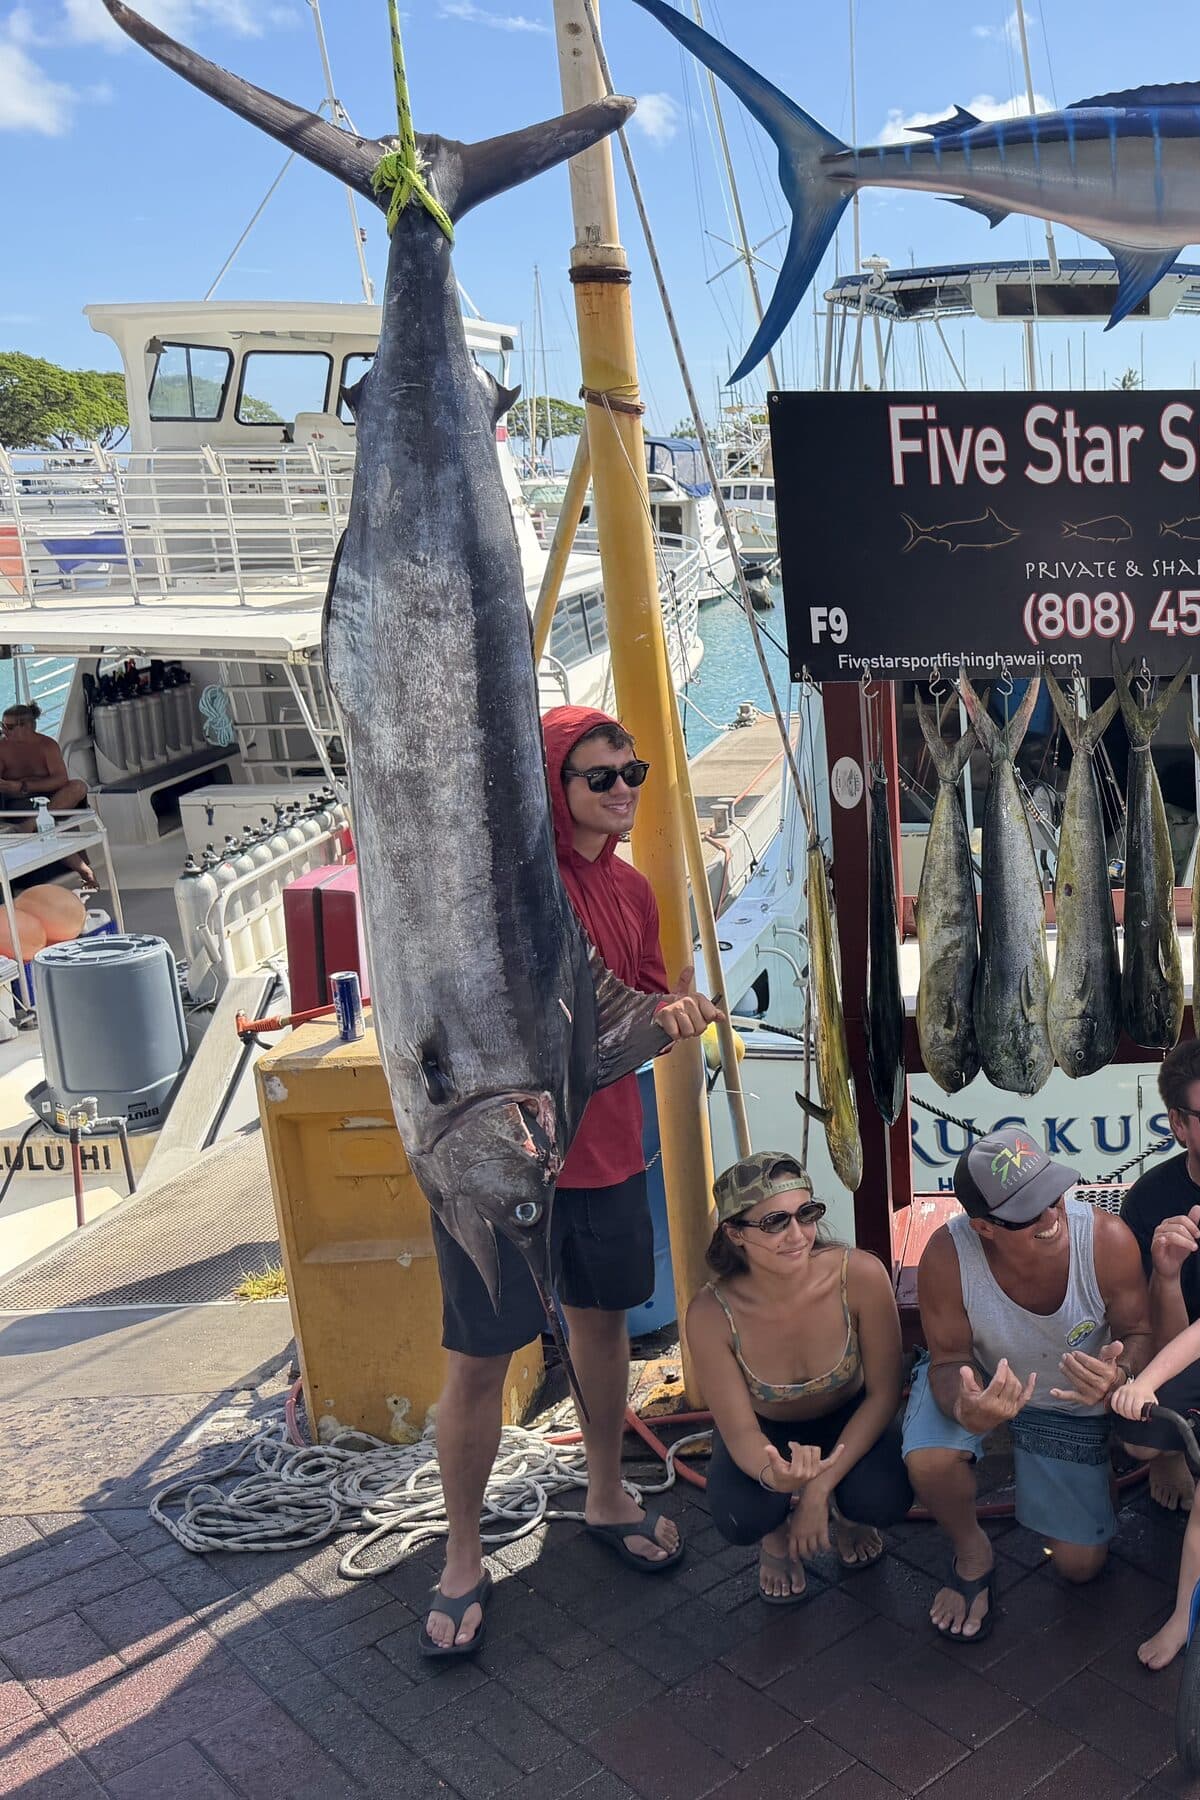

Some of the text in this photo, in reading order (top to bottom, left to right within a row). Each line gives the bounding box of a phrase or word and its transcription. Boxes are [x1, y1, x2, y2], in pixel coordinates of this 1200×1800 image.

[889, 406, 1006, 485] Five
[1024, 404, 1143, 485] Star
[1025, 559, 1117, 579] PRIVATE
[1126, 559, 1143, 577] &
[809, 606, 848, 644] F9
[1023, 591, 1135, 645] (808)
[838, 650, 1082, 671] Fivestarsportfishinghawaiicom
[123, 1106, 160, 1121] BRUT
[911, 1113, 1176, 1168] RUKUS
[80, 1145, 111, 1170] HI
